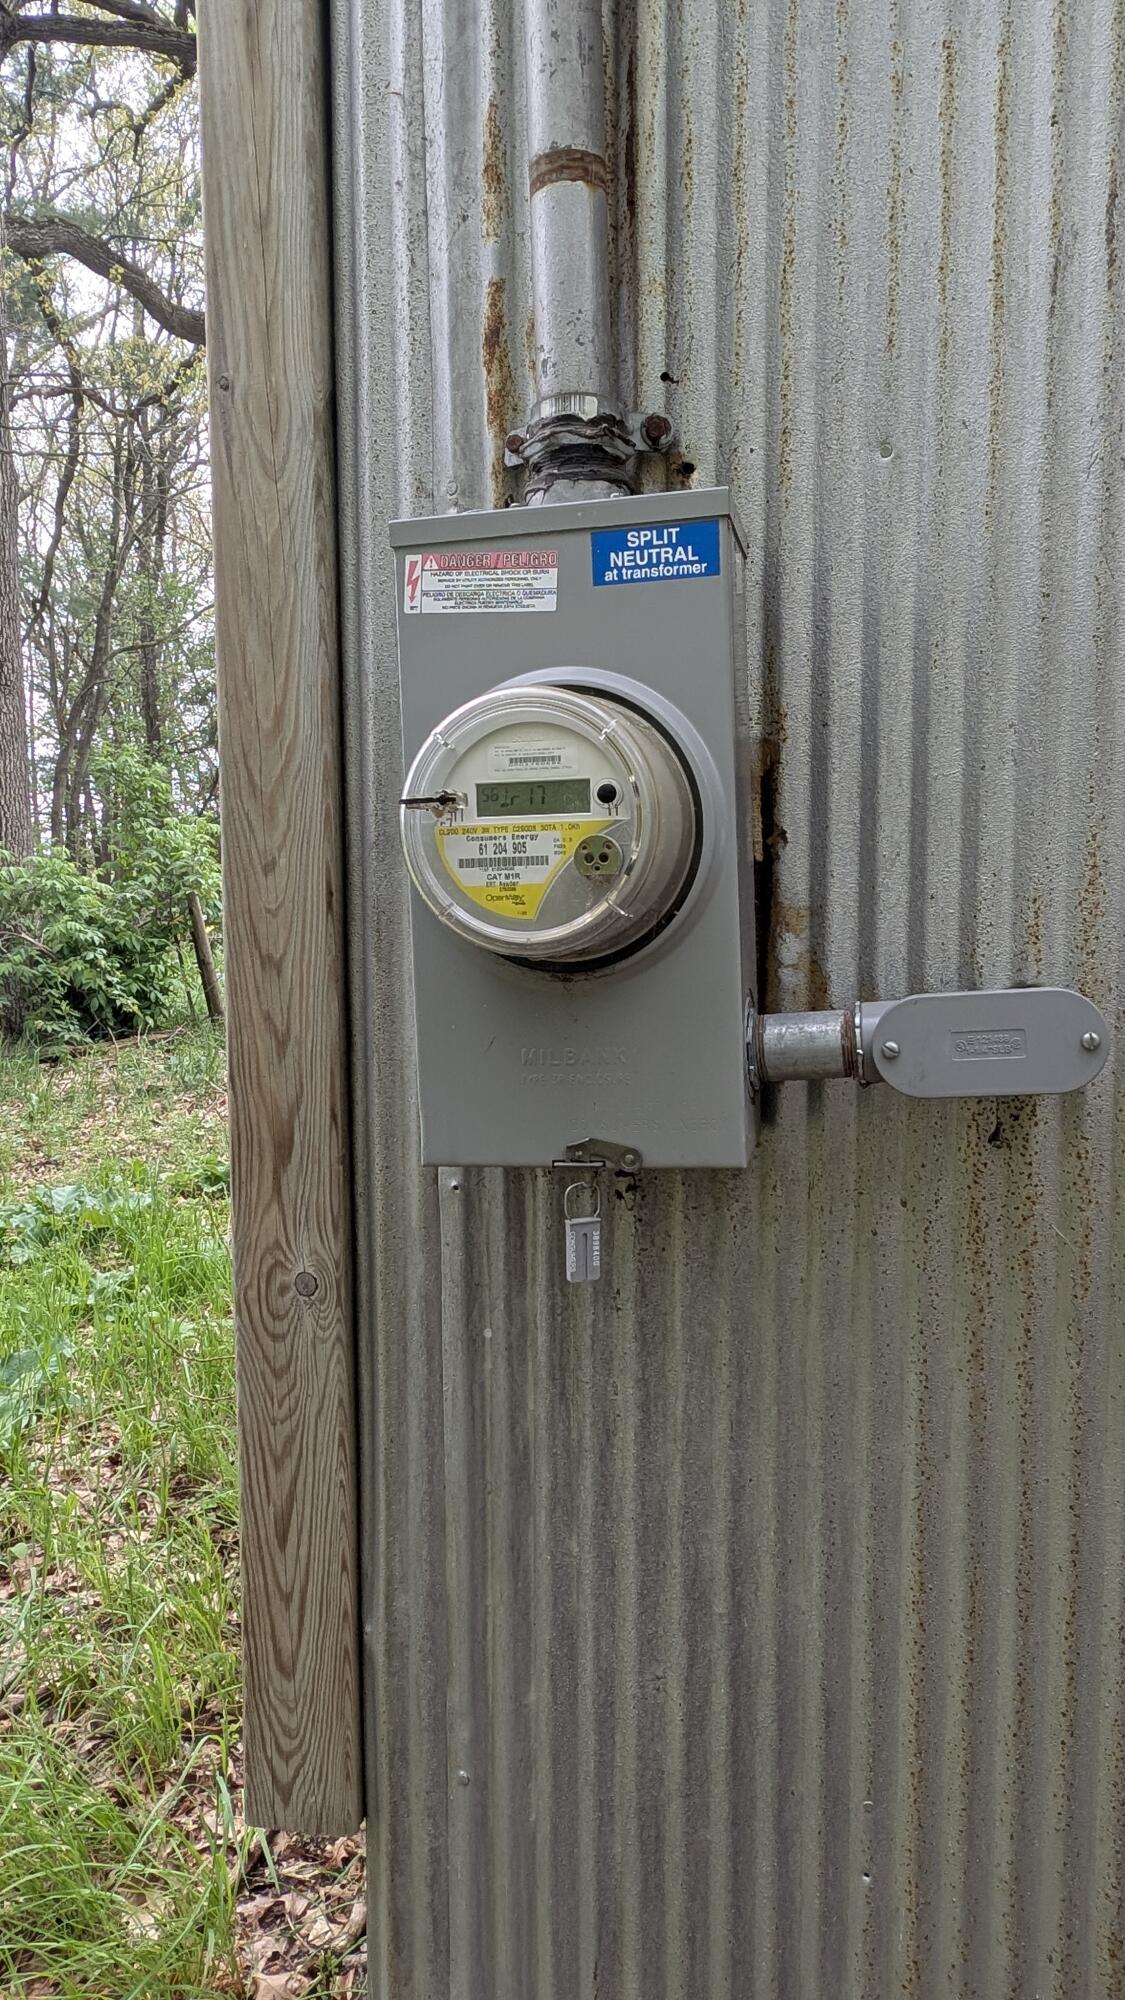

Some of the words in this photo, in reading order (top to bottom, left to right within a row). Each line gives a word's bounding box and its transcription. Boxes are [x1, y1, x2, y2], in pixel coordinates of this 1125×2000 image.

[627, 527, 680, 547] SPLIT
[440, 554, 491, 568] DANGER
[503, 552, 557, 567] PELIGRO
[609, 545, 699, 567] NEUTRAL
[604, 568, 618, 581] at
[621, 562, 708, 580] transformer
[466, 833, 507, 842] Consumers
[511, 833, 539, 843] Energy
[493, 826, 509, 834] TYPE
[478, 842, 489, 856] 61
[493, 842, 508, 856] 204
[512, 841, 527, 855] 905
[486, 873, 502, 881] CAT
[504, 872, 521, 880] M1R
[520, 1047, 627, 1065] MILBANK
